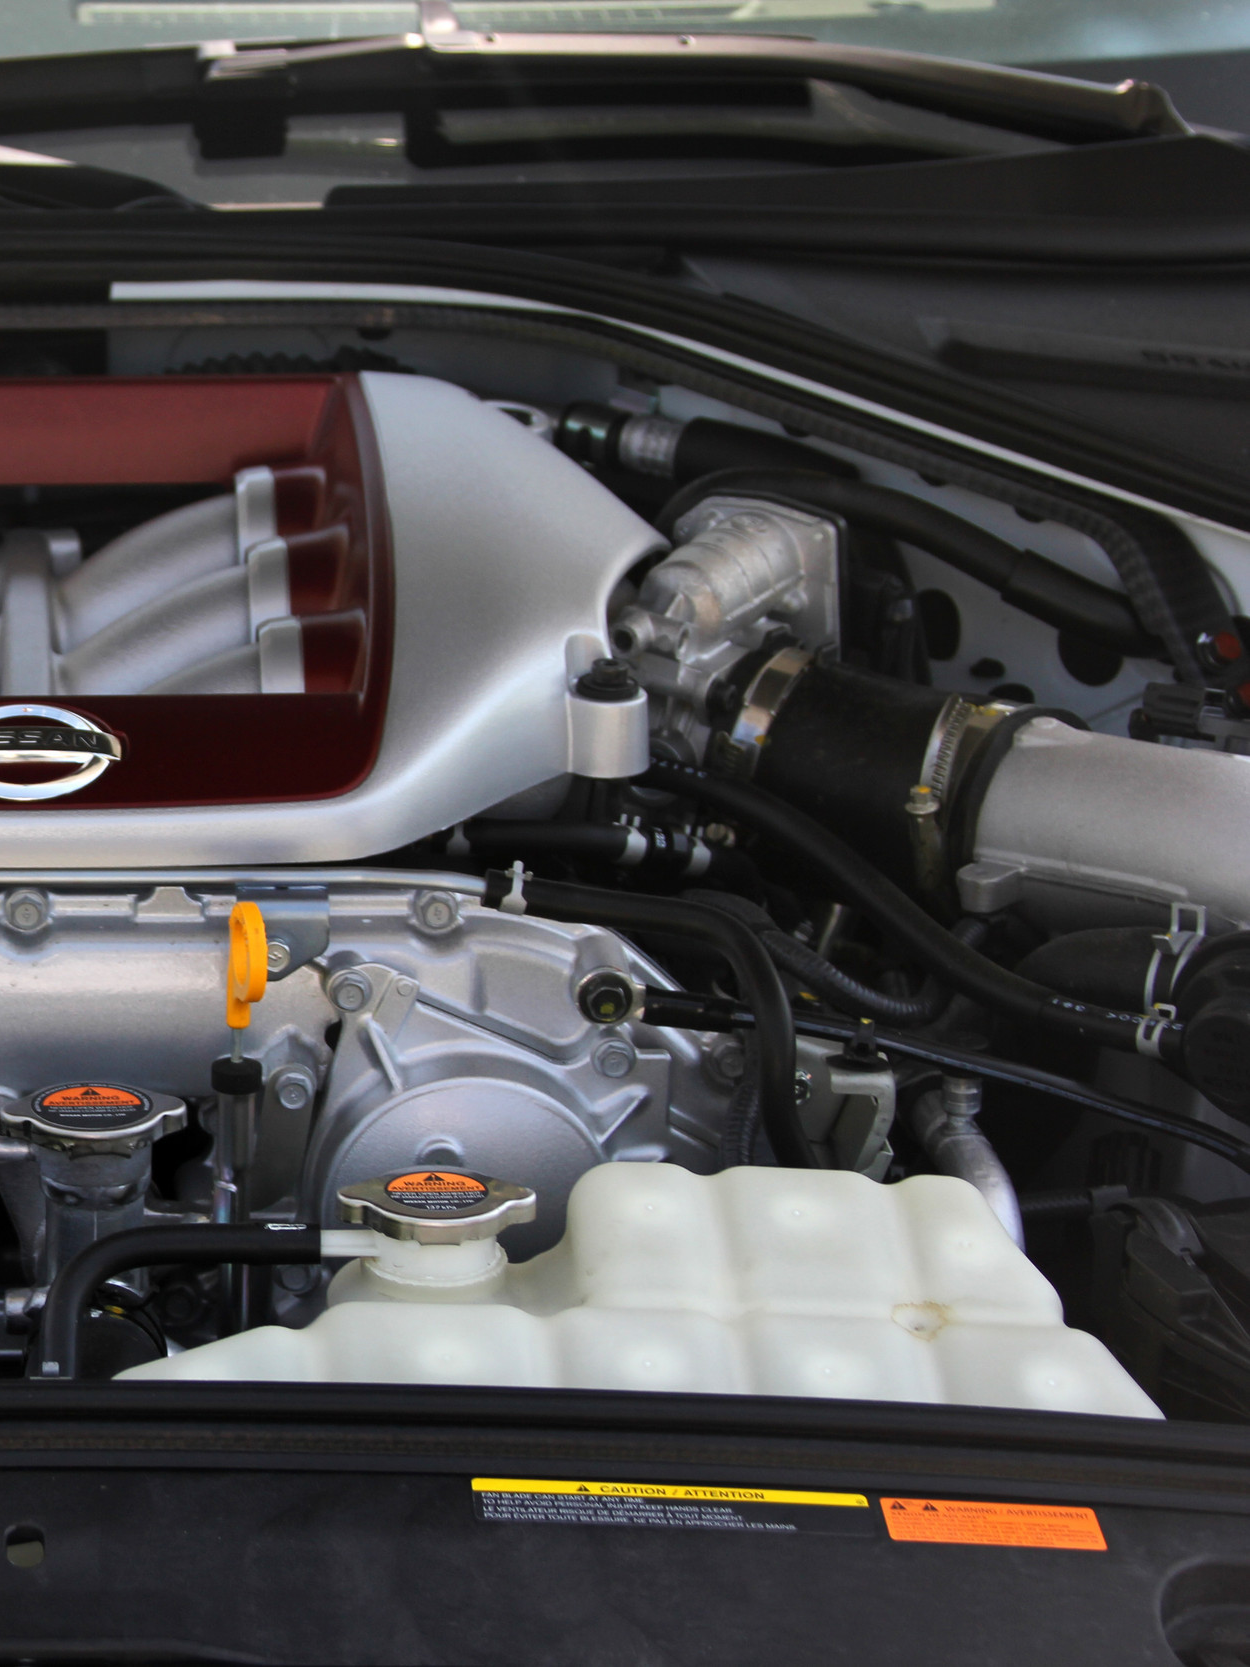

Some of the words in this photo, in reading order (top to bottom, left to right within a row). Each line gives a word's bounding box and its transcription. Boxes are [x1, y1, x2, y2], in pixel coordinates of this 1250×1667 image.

[600, 1485, 667, 1496] CAUTION
[684, 1489, 765, 1500] ATTENTION
[944, 1505, 998, 1514] WARNING
[1006, 1508, 1089, 1520] AVERTISSEMENT
[685, 1519, 745, 1528] APPROCHER
